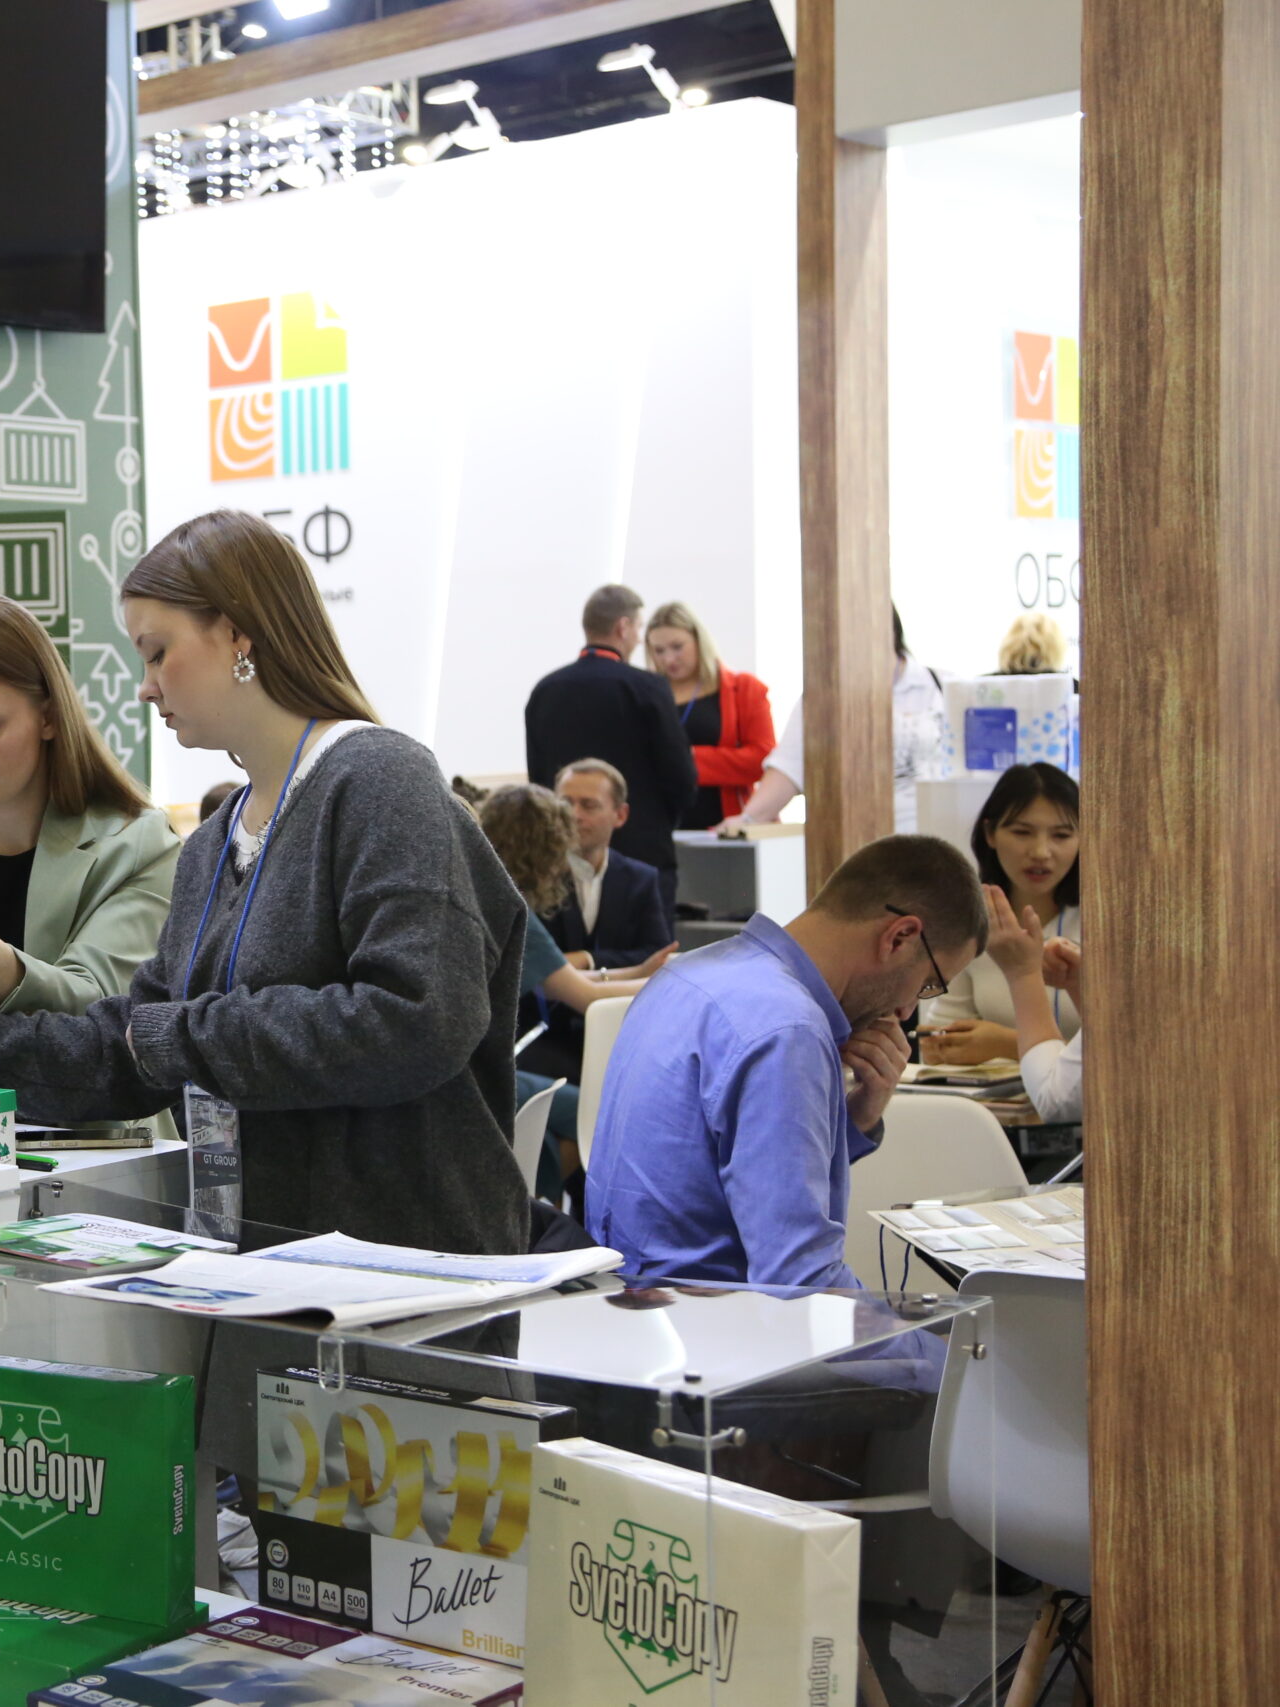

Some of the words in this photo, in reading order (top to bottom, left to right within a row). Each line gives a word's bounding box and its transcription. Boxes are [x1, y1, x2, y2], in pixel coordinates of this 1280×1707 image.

[203, 1154, 213, 1165] GT
[213, 1155, 237, 1167] GROUP
[172, 1463, 184, 1536] SvetoCopy
[272, 1577, 284, 1589] 80
[297, 1584, 311, 1593] 110
[322, 1590, 336, 1601] A4
[347, 1595, 366, 1608] 500
[392, 1556, 504, 1631] Ballet
[569, 1541, 738, 1682] SvetoCopy
[335, 1649, 481, 1676] Ballet
[396, 1674, 473, 1699] Premier
